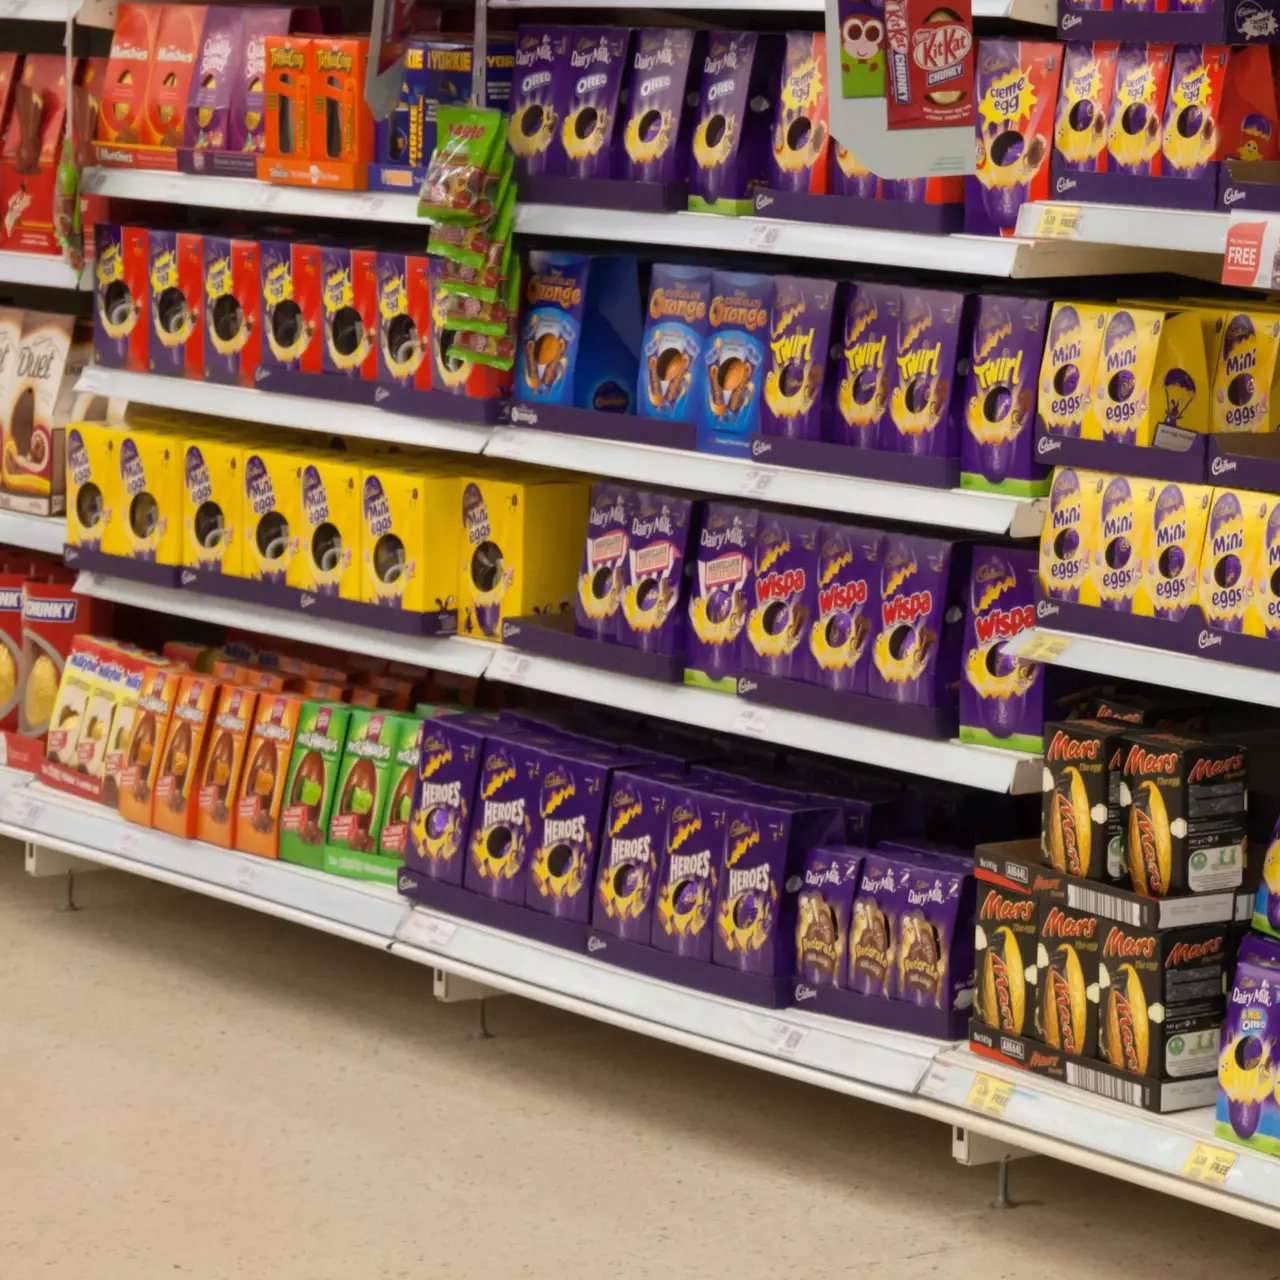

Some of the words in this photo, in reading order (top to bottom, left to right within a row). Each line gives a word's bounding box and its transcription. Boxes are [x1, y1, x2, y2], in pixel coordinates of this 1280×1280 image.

[895, 54, 909, 102] CHUNKY
[757, 568, 804, 600] Wispa
[1048, 733, 1101, 761] Mars
[422, 780, 462, 804] HEROES
[1042, 907, 1097, 937] Mars
